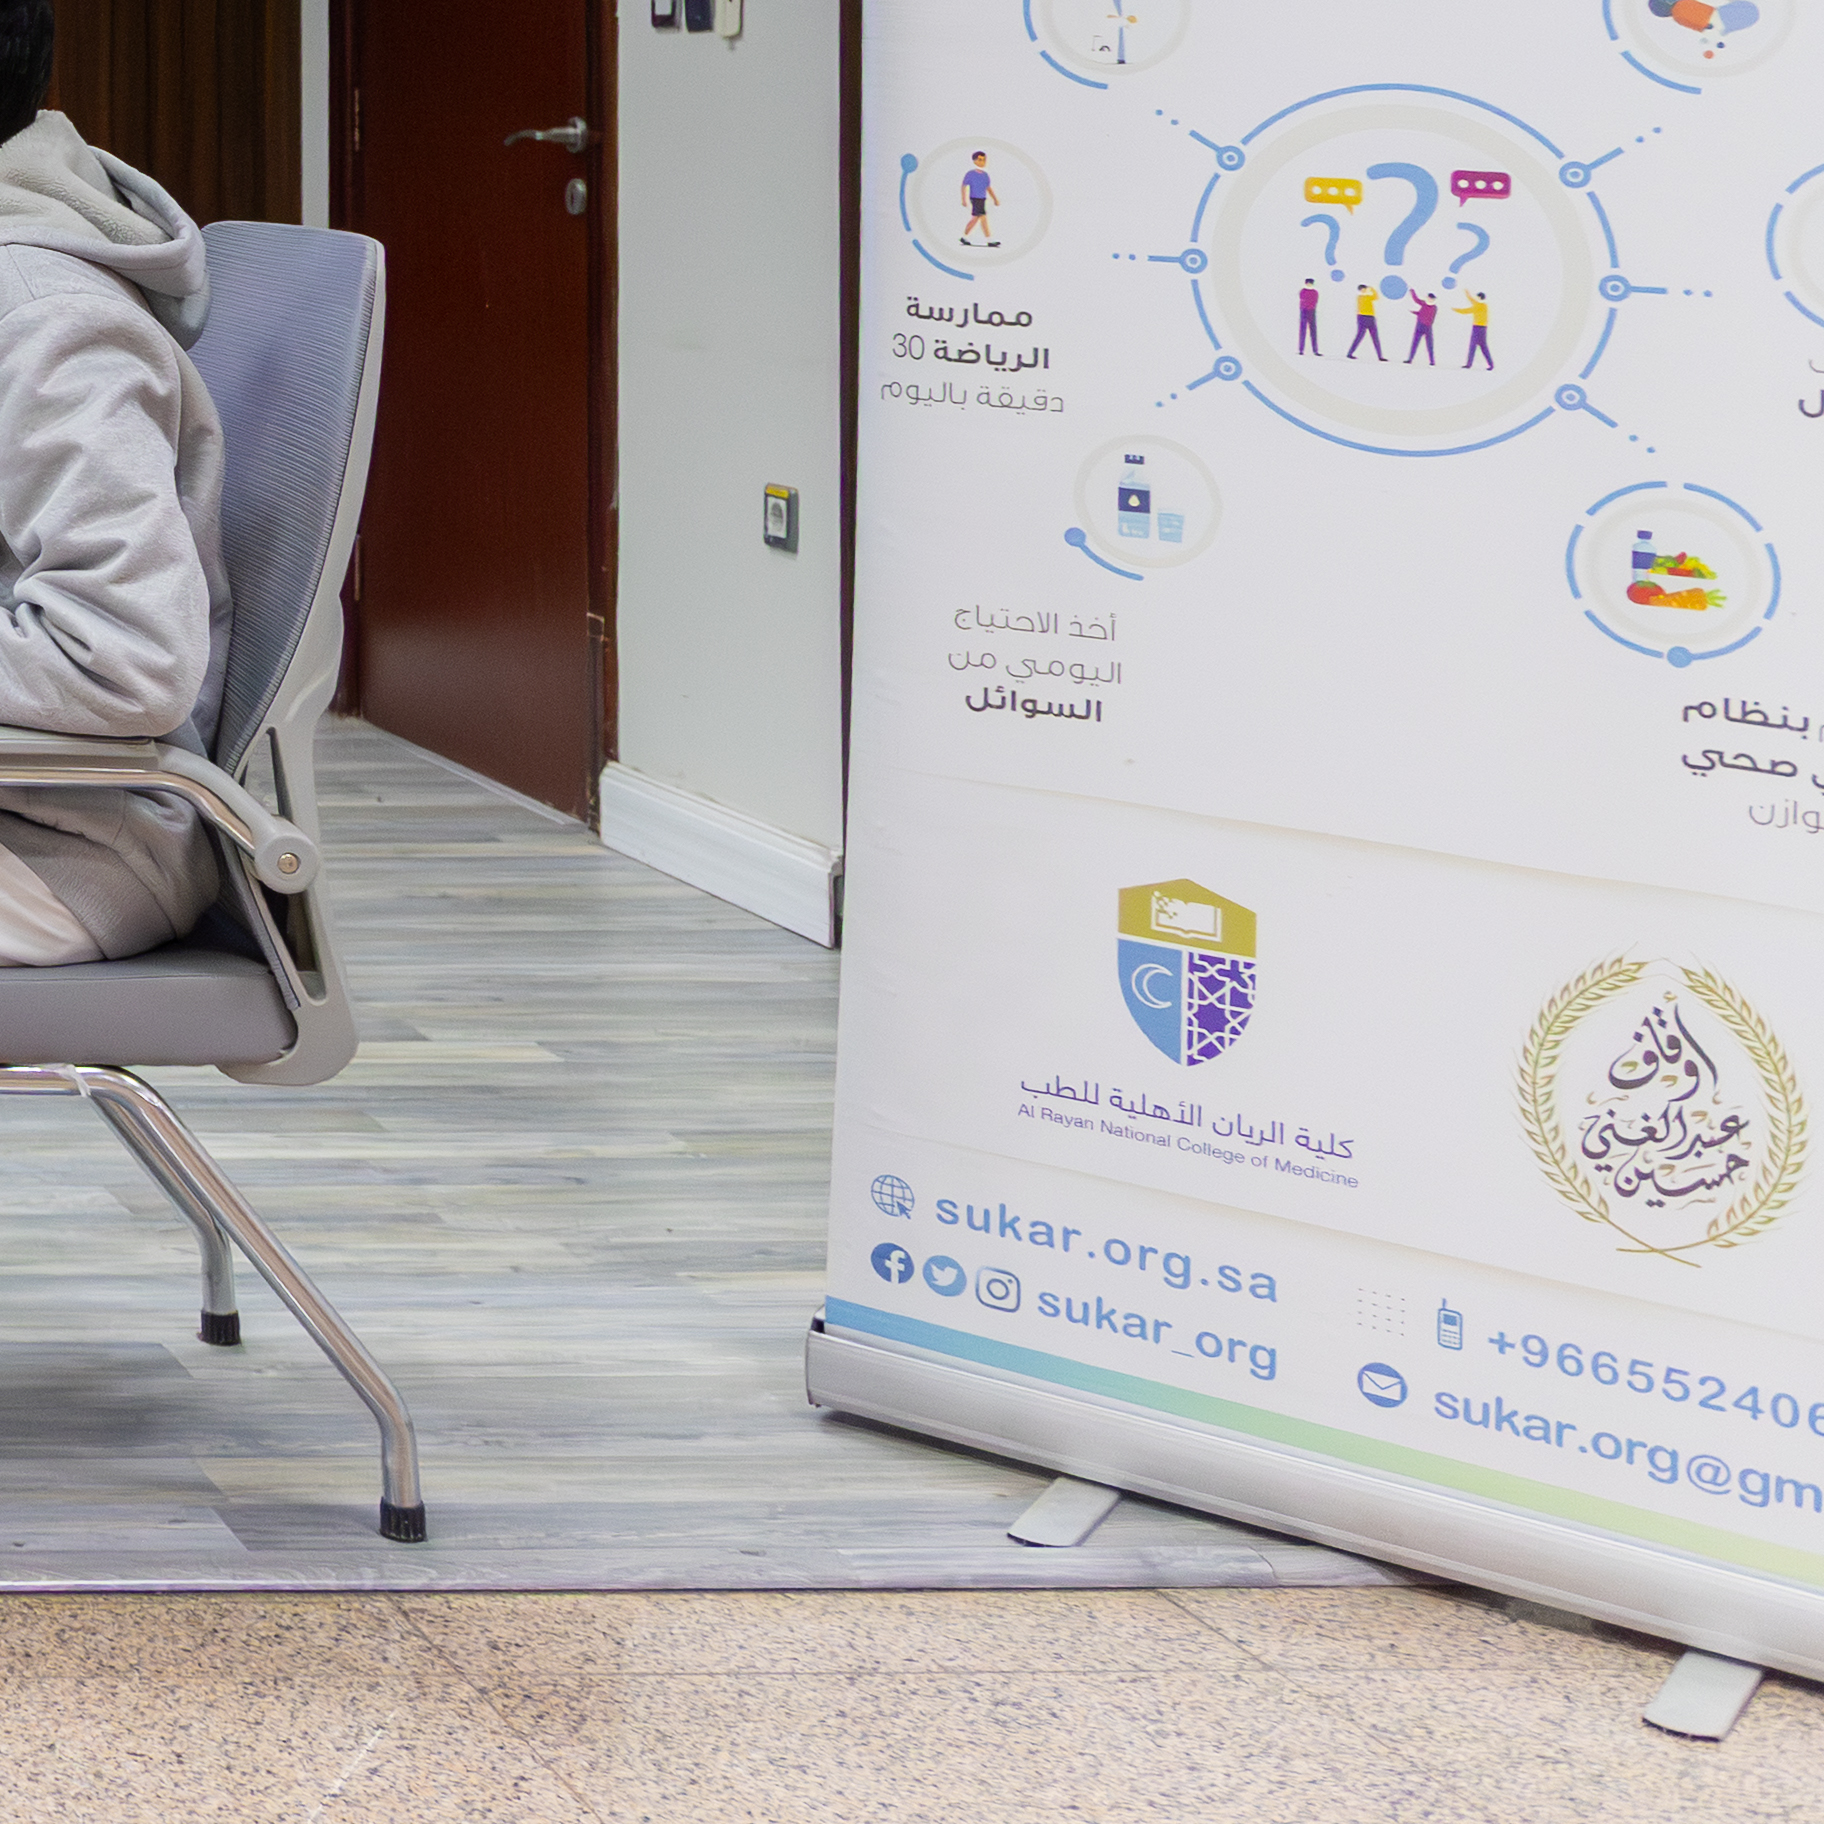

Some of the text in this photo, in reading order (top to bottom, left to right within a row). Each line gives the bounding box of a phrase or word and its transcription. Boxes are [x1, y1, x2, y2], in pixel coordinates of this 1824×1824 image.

[906, 296, 1033, 328] ممارسة
[892, 332, 1050, 372] الرياضة 30
[881, 381, 1064, 415] دقيقة باليوم
[954, 604, 1117, 641] أخذ الاحتياج
[948, 650, 1122, 687] اليومي من
[965, 685, 1102, 722] السوائل
[1682, 697, 1809, 740] بنظام
[1681, 749, 1798, 777] صحي
[1020, 1074, 1355, 1160] كلية الريان الأهلية للطب
[1017, 1103, 1359, 1189] Al Rayan National College of Medicine
[936, 1198, 1277, 1303] sukar.org.sa
[1038, 1291, 1278, 1381] sukar_org
